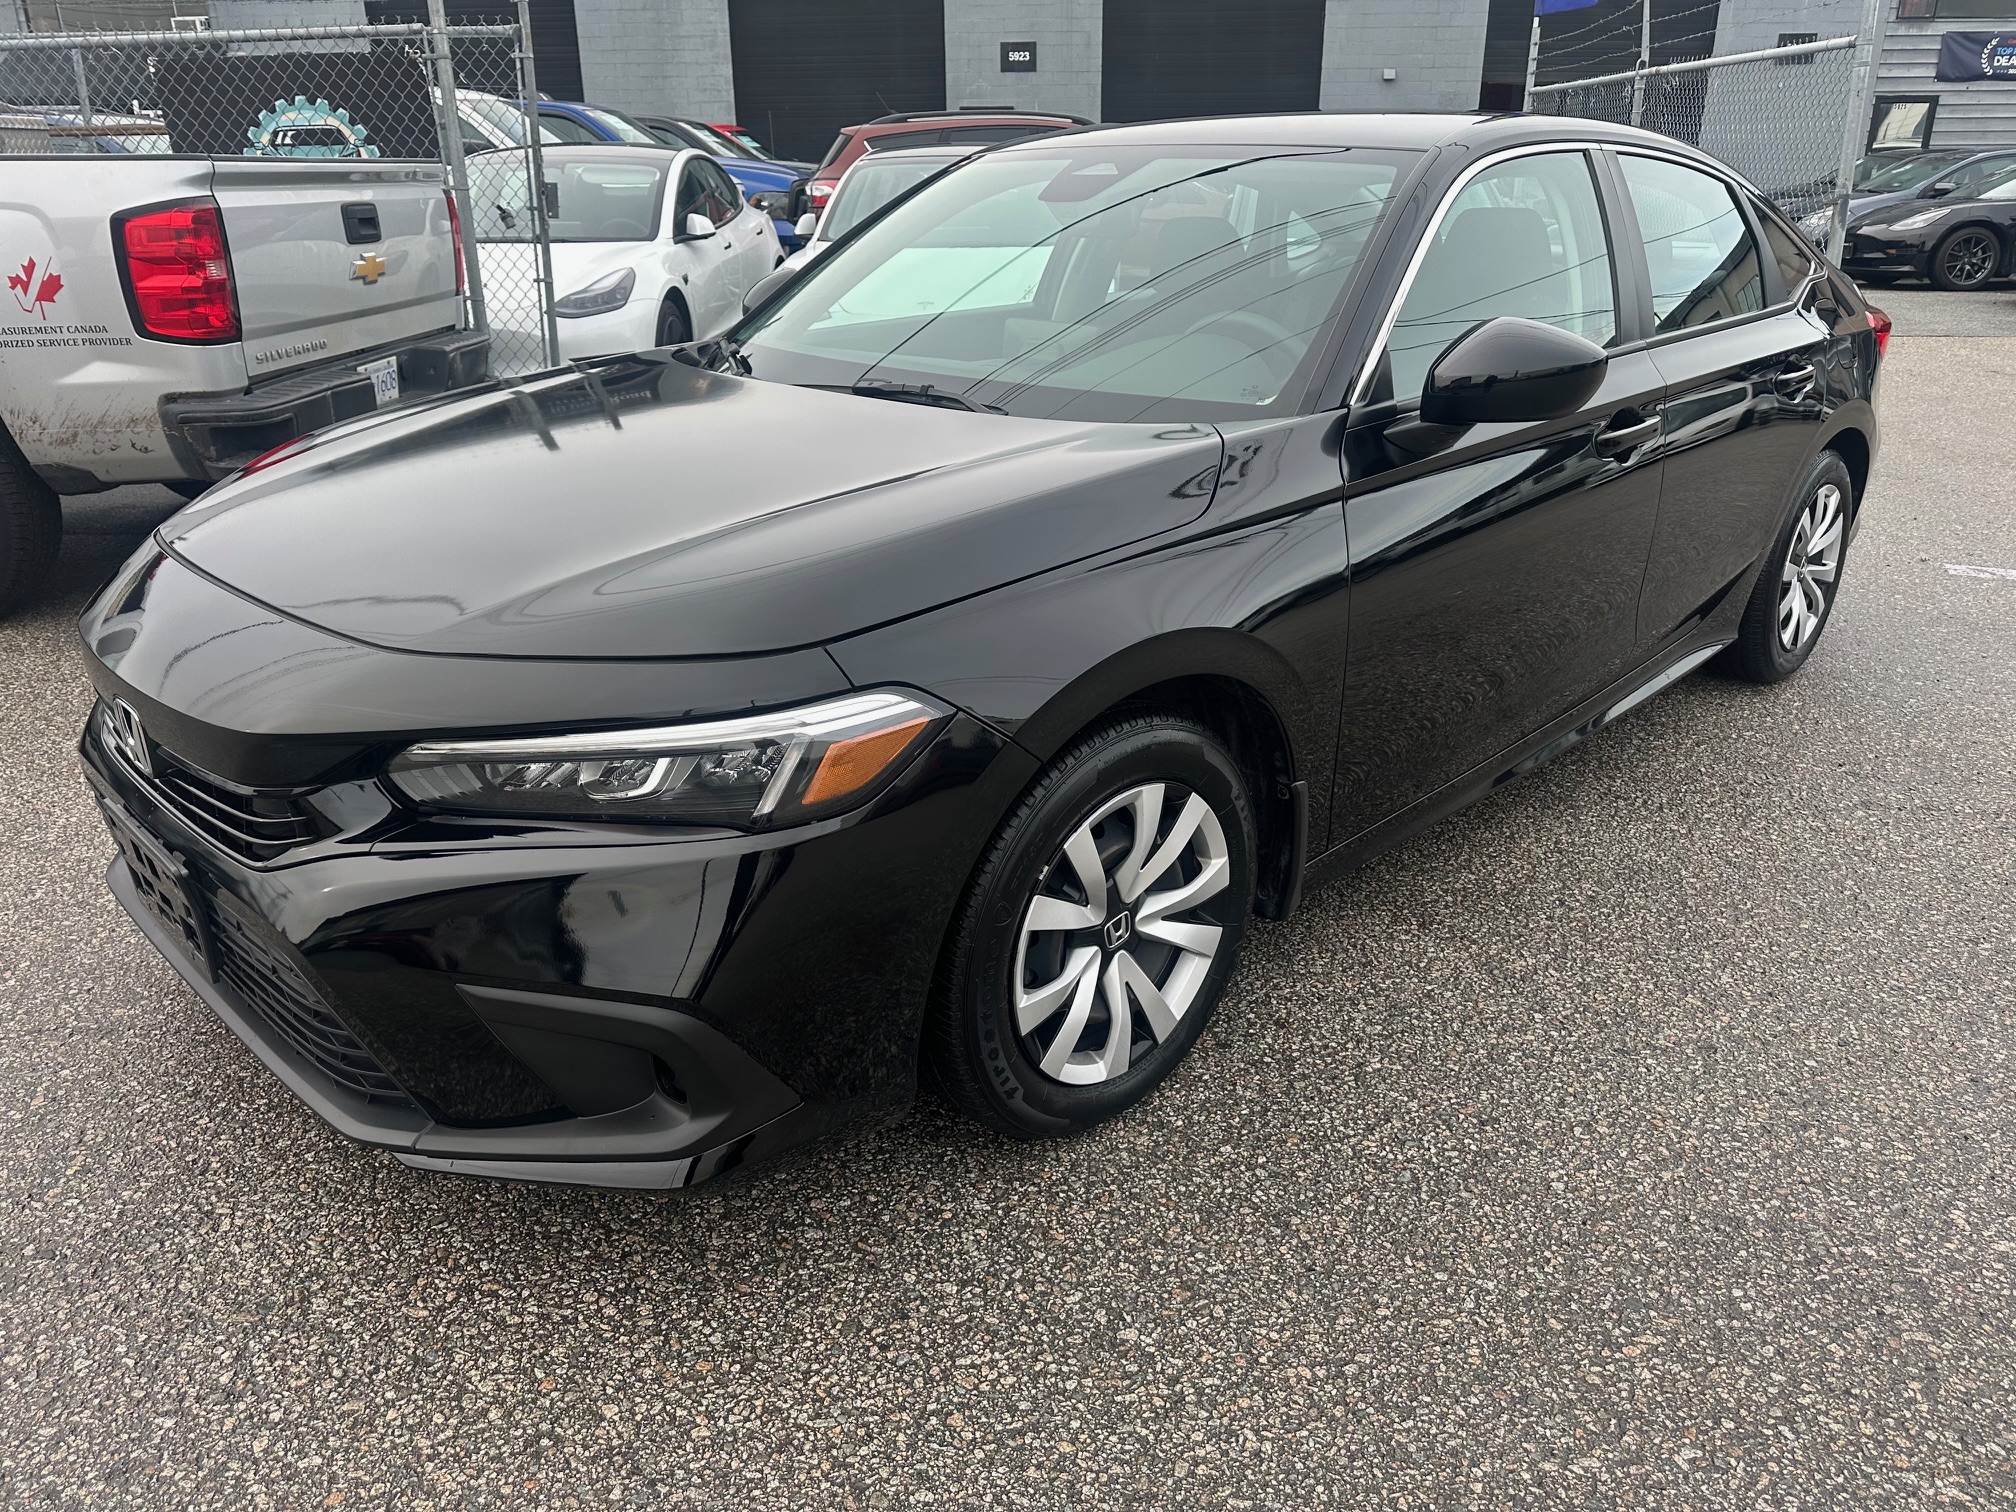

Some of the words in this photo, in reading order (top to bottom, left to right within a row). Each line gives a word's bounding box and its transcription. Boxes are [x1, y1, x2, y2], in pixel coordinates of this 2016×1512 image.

[1008, 51, 1030, 61] 5923
[1996, 47, 2013, 55] TOP
[0, 325, 64, 336] ASUREMENT
[66, 325, 109, 334] CANADA
[36, 338, 80, 348] SERVICE
[82, 337, 133, 346] PROVIDER
[255, 338, 328, 365] SILVERADO
[376, 369, 396, 395] 1608
